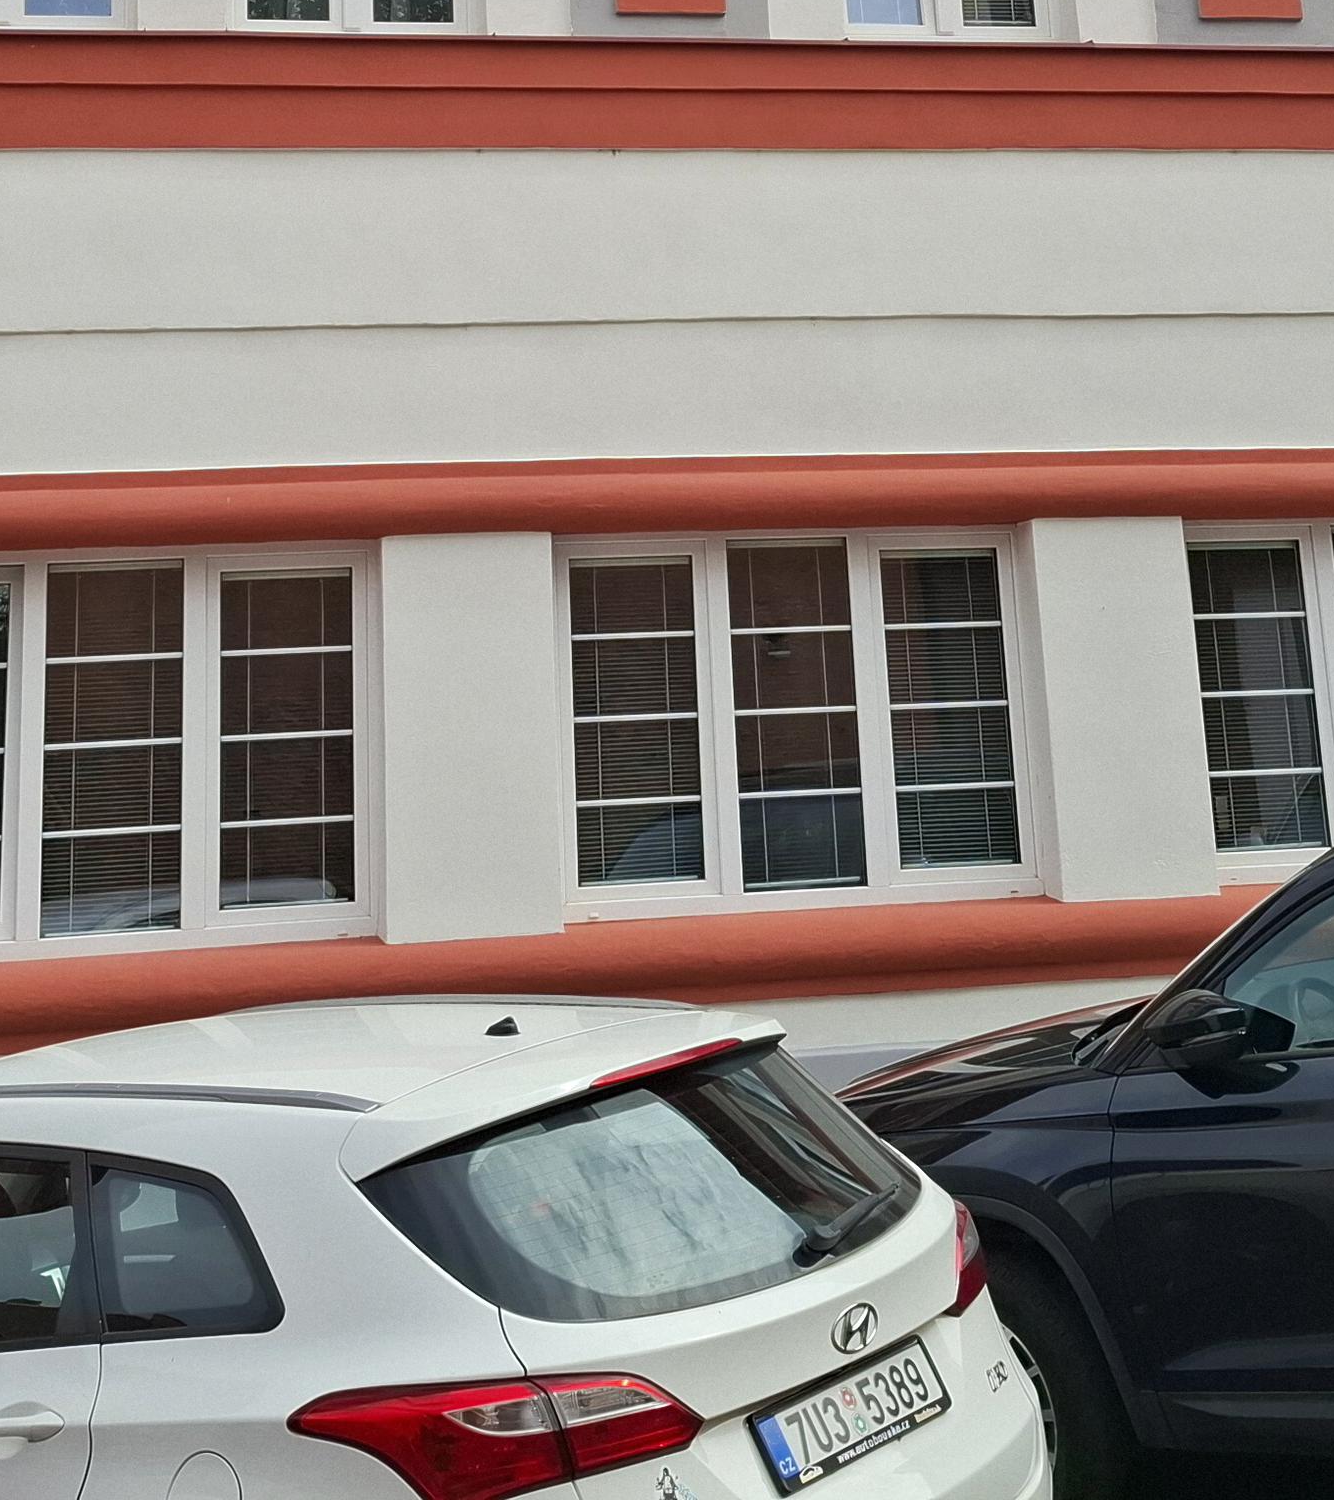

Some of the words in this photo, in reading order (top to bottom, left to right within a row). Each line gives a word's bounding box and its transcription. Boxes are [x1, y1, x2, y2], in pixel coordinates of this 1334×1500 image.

[784, 1397, 851, 1466] 7U3
[855, 1358, 929, 1425] 5389
[779, 1457, 798, 1475] CZ
